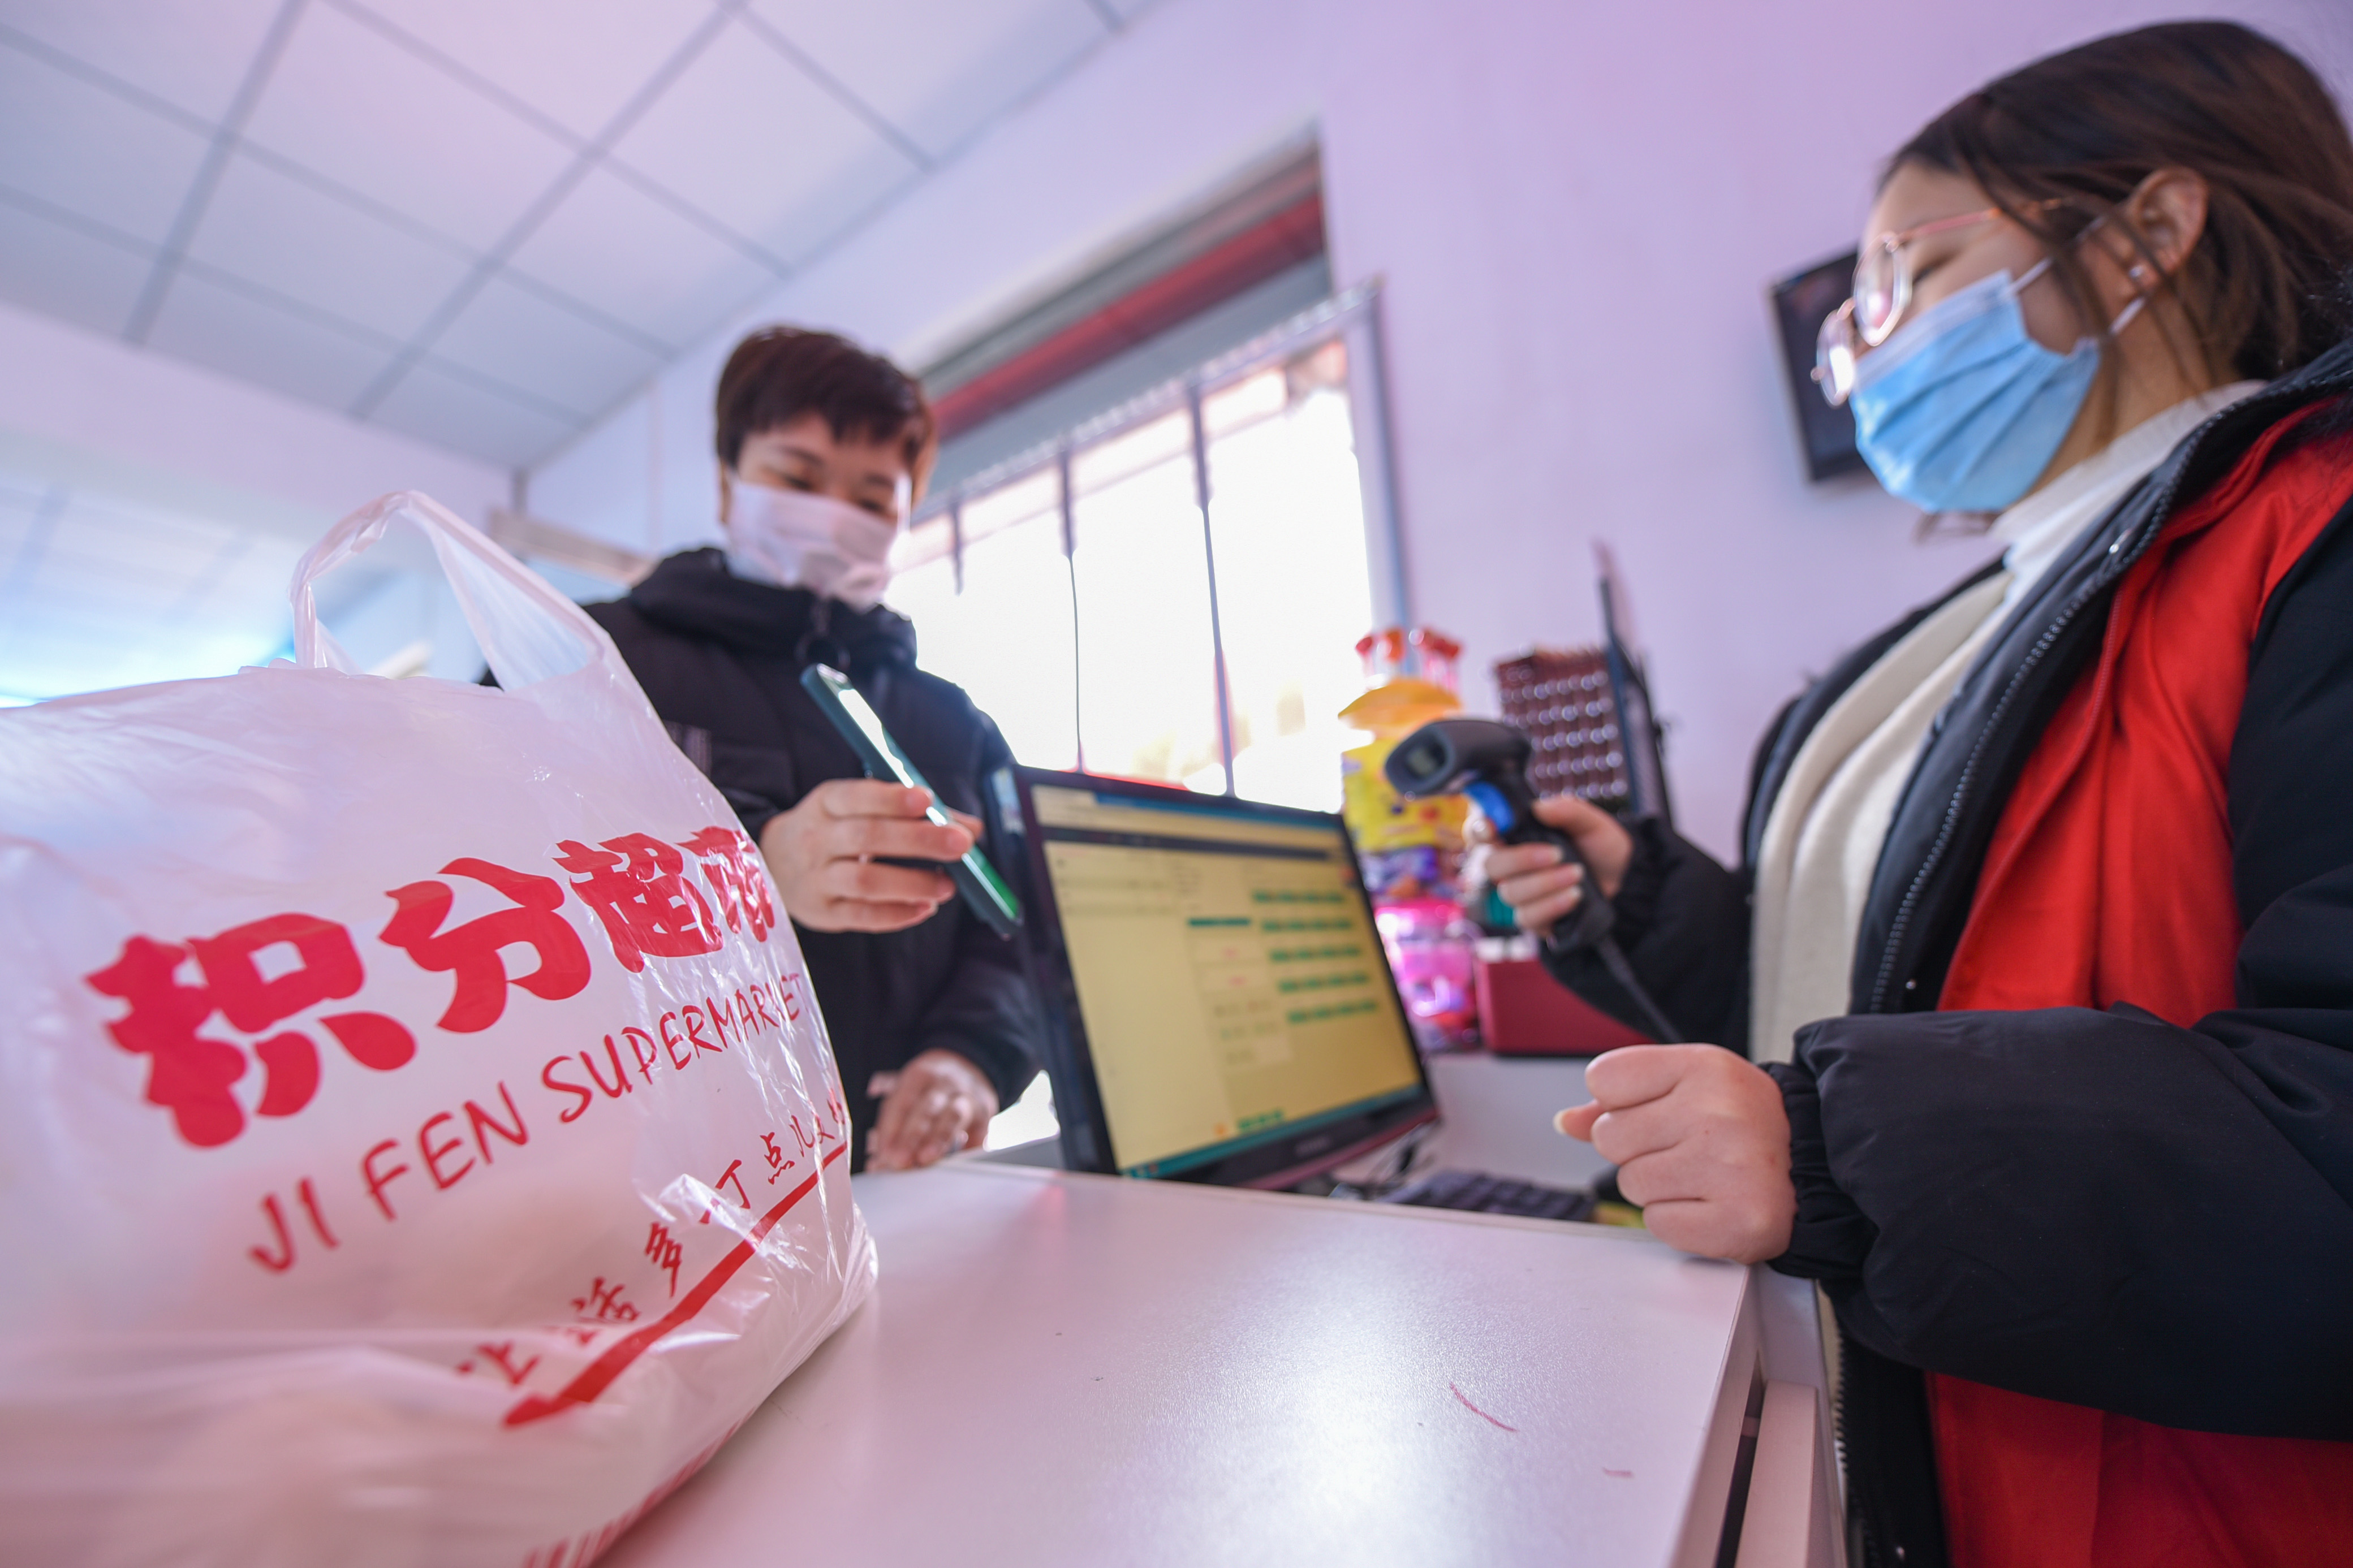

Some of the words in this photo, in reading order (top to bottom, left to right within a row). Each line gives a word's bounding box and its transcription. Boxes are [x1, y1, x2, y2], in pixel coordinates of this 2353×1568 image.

[81, 825, 775, 1150] 积分超市
[248, 1177, 339, 1273] JI
[361, 1080, 529, 1219] FEN
[540, 973, 808, 1124] SUPERMARKET
